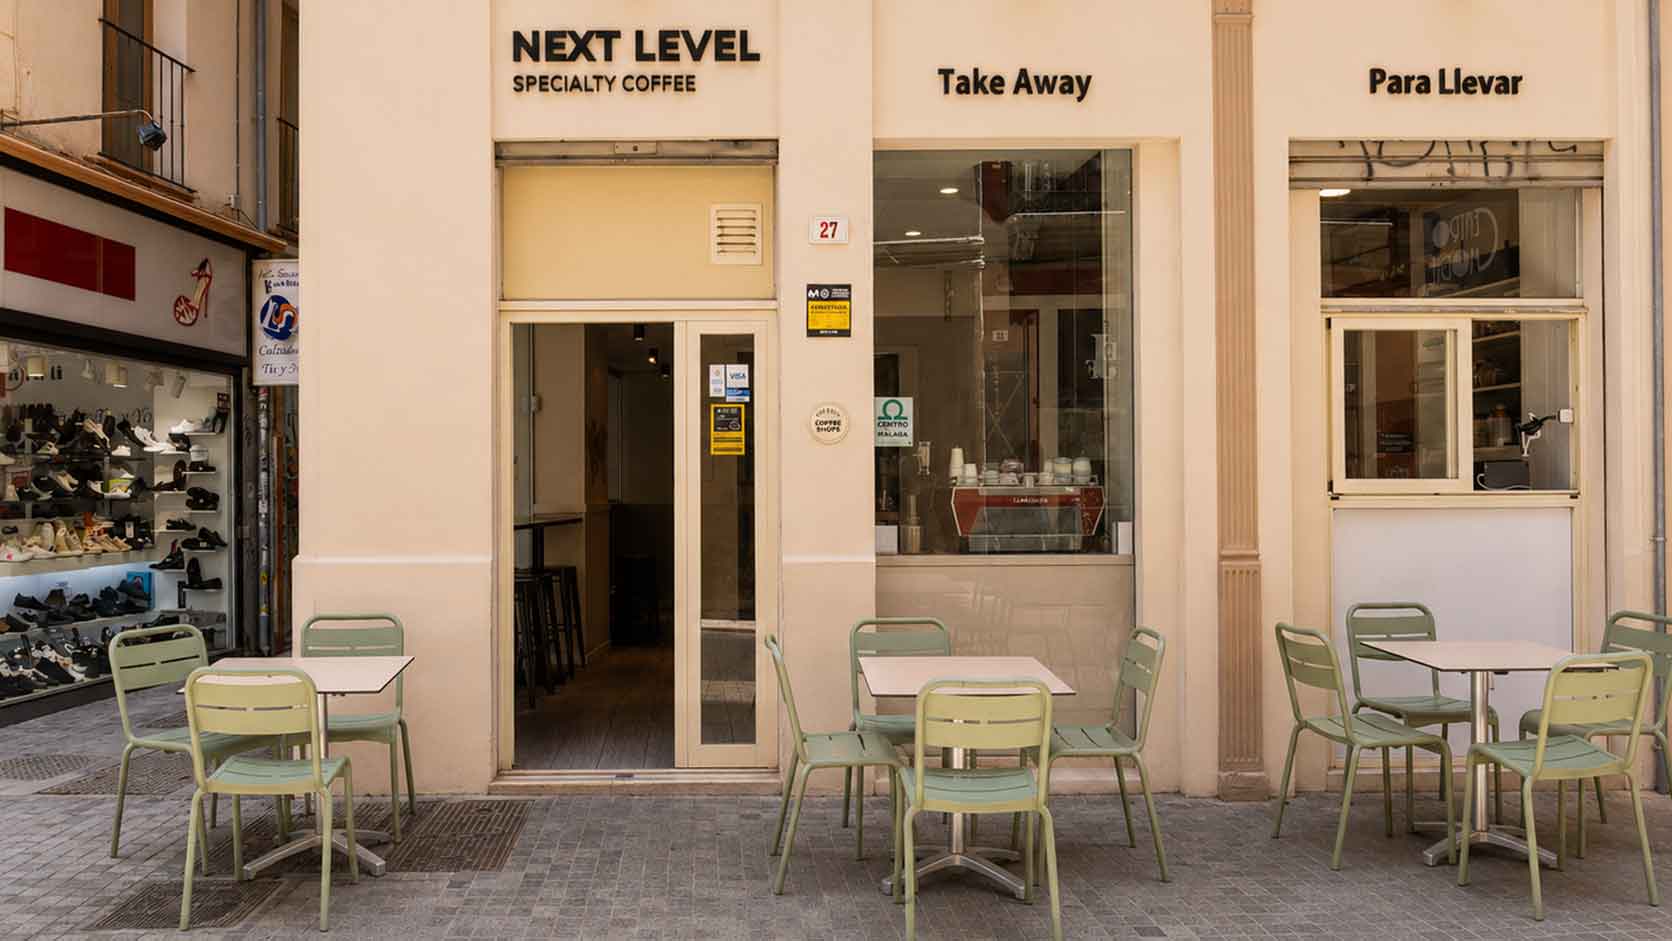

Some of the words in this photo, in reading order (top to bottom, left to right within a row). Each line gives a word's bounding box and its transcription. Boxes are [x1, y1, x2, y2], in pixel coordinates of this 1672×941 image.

[513, 30, 621, 62] NEXT
[635, 30, 760, 62] LEVEL
[513, 75, 616, 92] SPECIALTY
[622, 75, 696, 92] COFFEE
[938, 68, 1005, 95] Take
[1013, 68, 1092, 102] Away
[1370, 67, 1431, 95] Para
[1439, 67, 1523, 95] Llevar
[820, 222, 838, 239] 27
